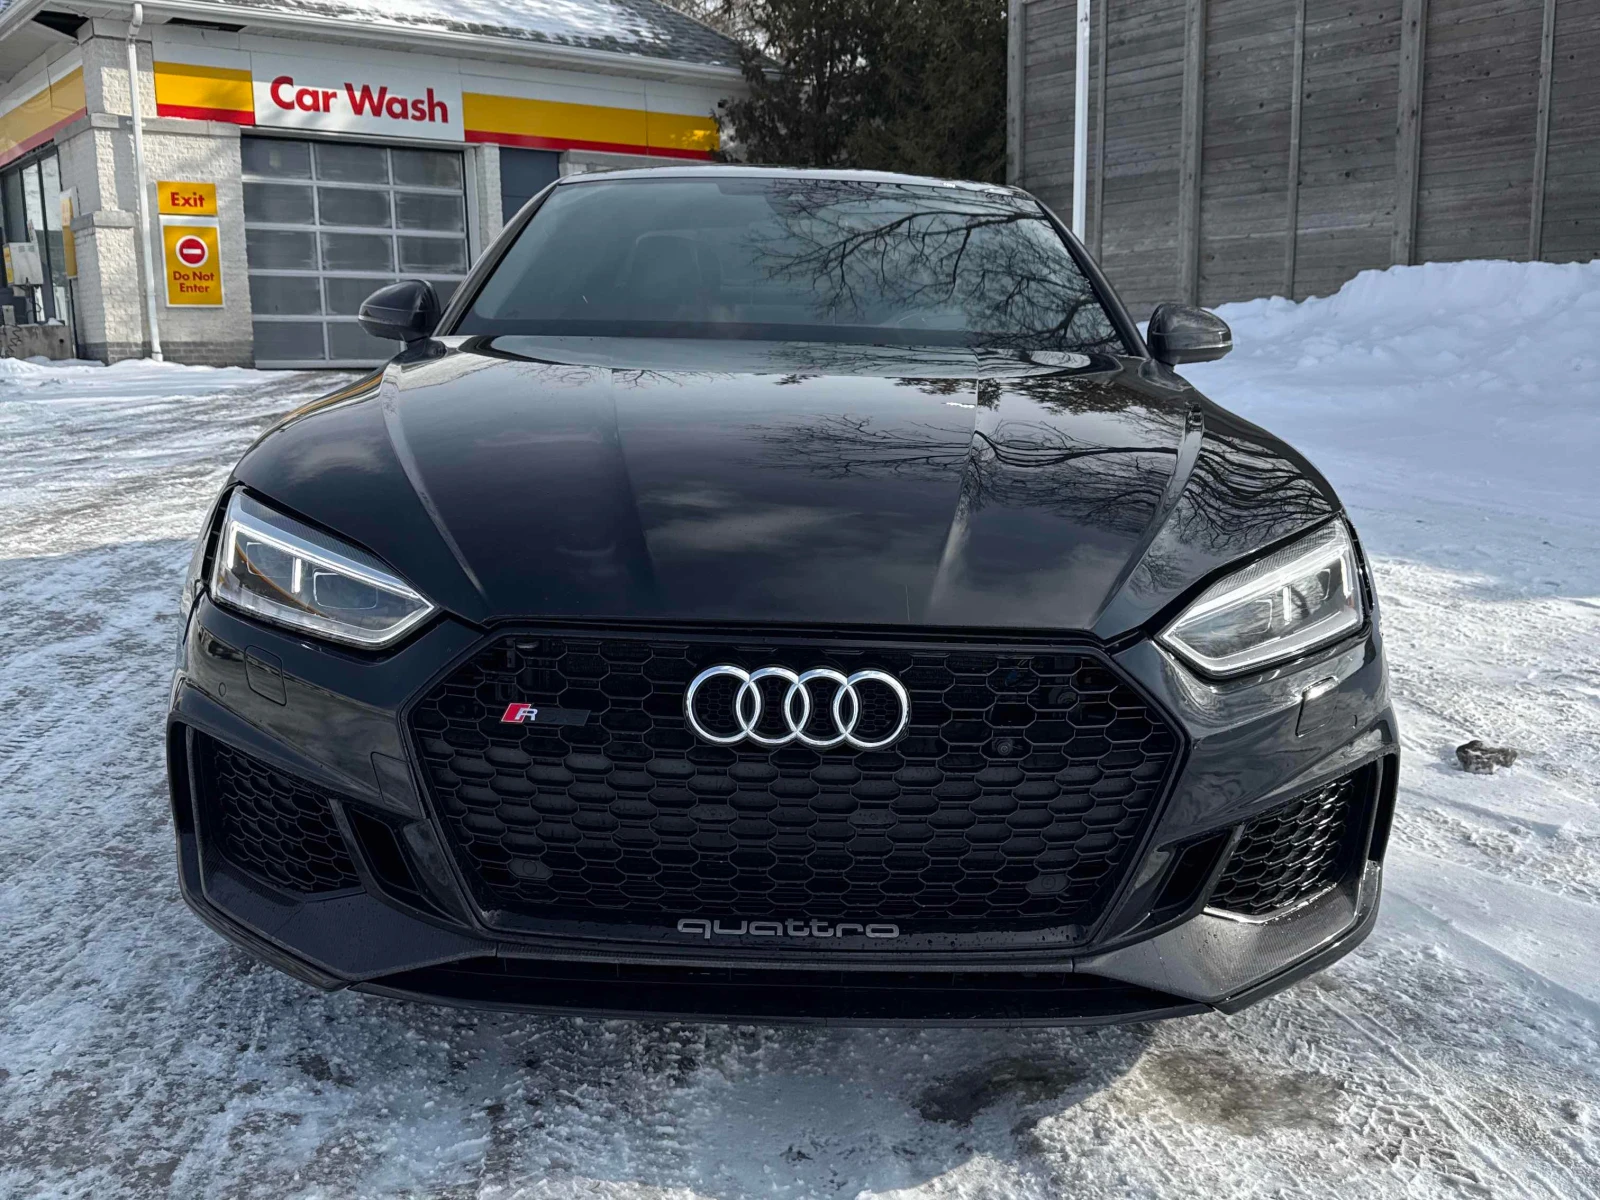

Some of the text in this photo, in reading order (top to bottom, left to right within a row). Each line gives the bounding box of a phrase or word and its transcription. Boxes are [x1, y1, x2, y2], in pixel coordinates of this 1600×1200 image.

[270, 75, 449, 124] Car Wash
[170, 191, 205, 208] Exit
[173, 270, 215, 282] Do Not
[179, 282, 210, 293] Enter
[677, 918, 900, 939] quattro
